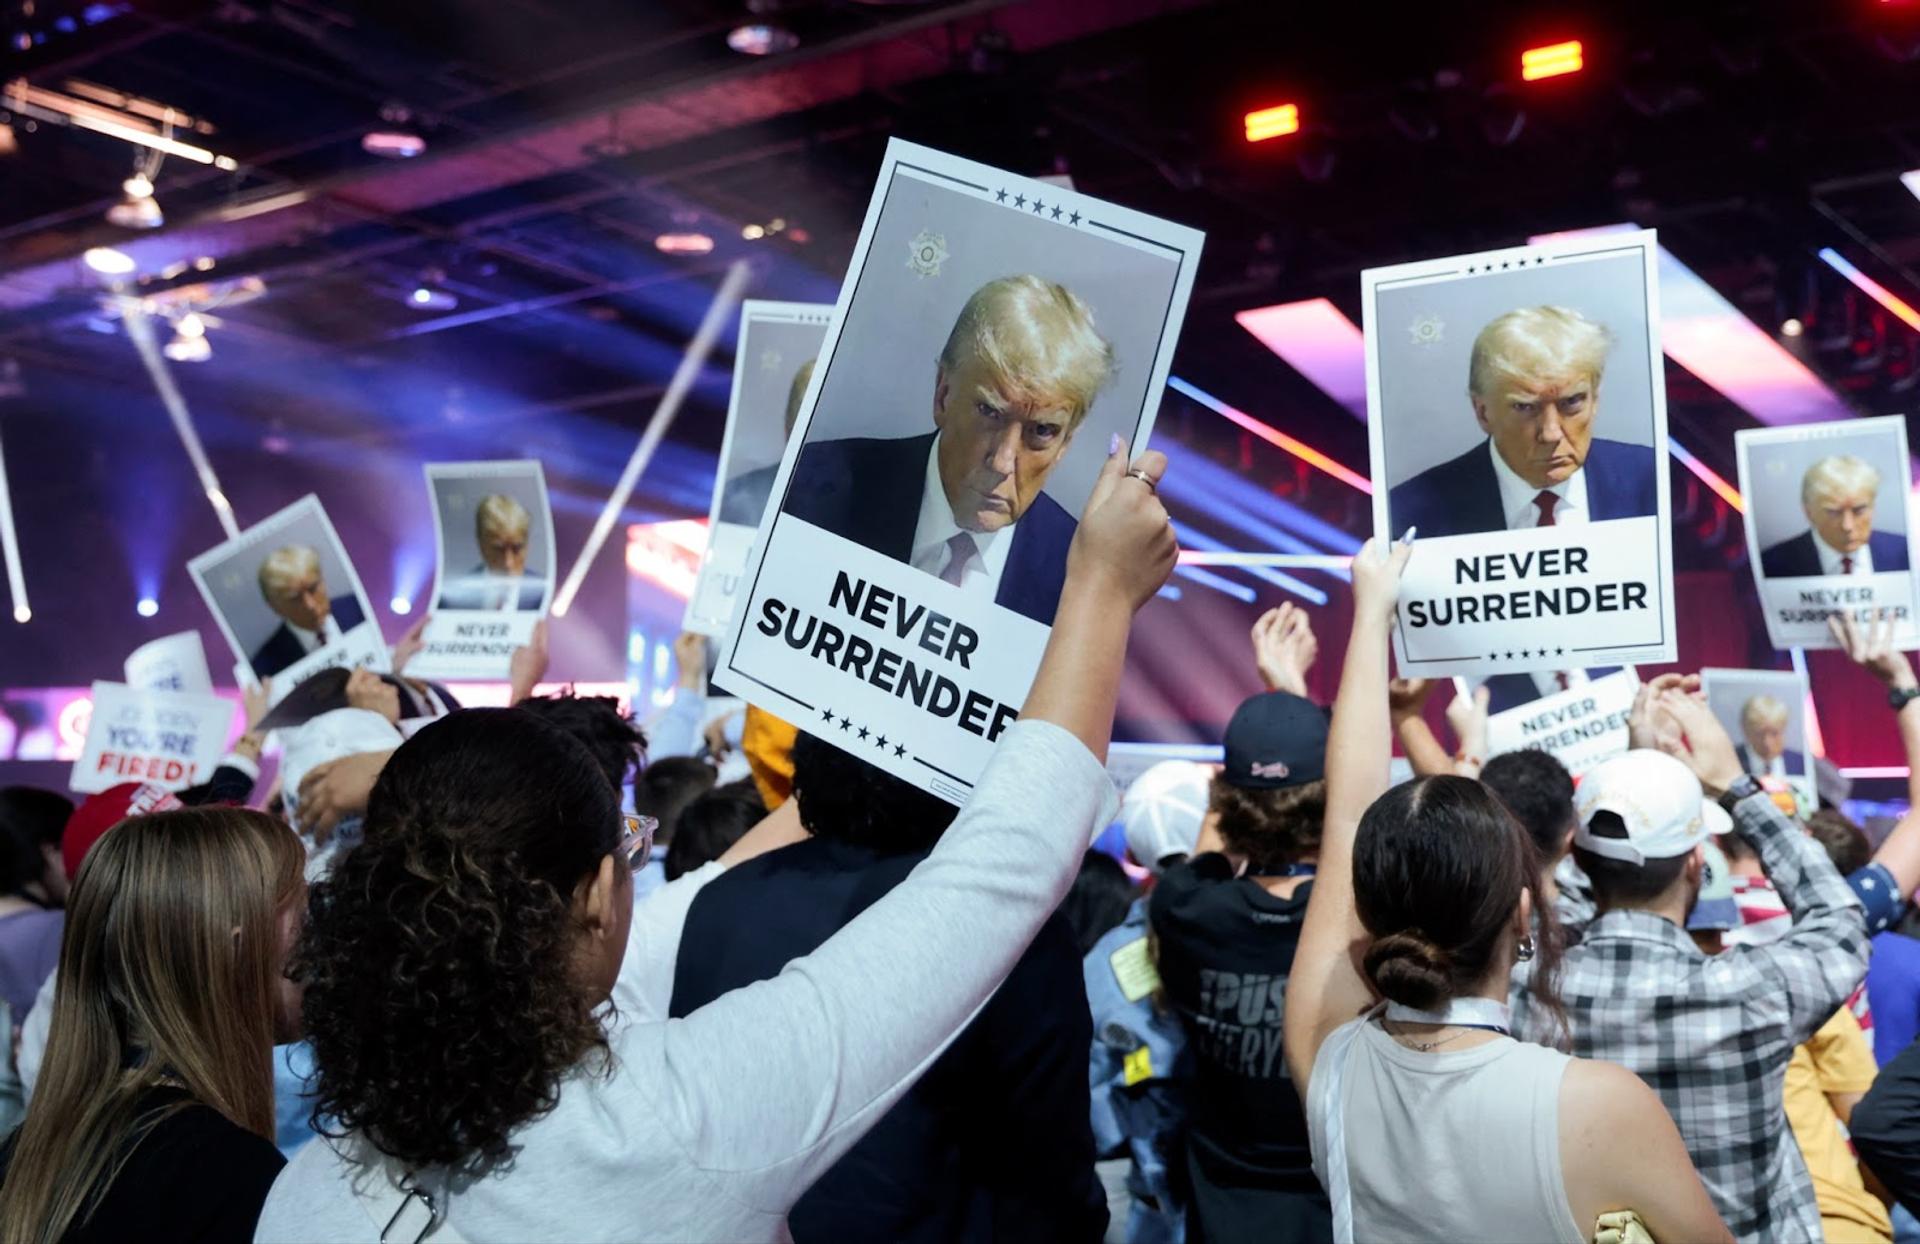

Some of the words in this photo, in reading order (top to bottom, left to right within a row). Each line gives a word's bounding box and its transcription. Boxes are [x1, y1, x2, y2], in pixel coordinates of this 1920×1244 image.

[1455, 547, 1588, 585] NEVER
[1408, 581, 1648, 628] SURRENDER
[1799, 588, 1873, 604] NEVER
[828, 570, 979, 670] NEVER
[1521, 698, 1596, 736] NEVER
[97, 751, 198, 785] FIRED!
